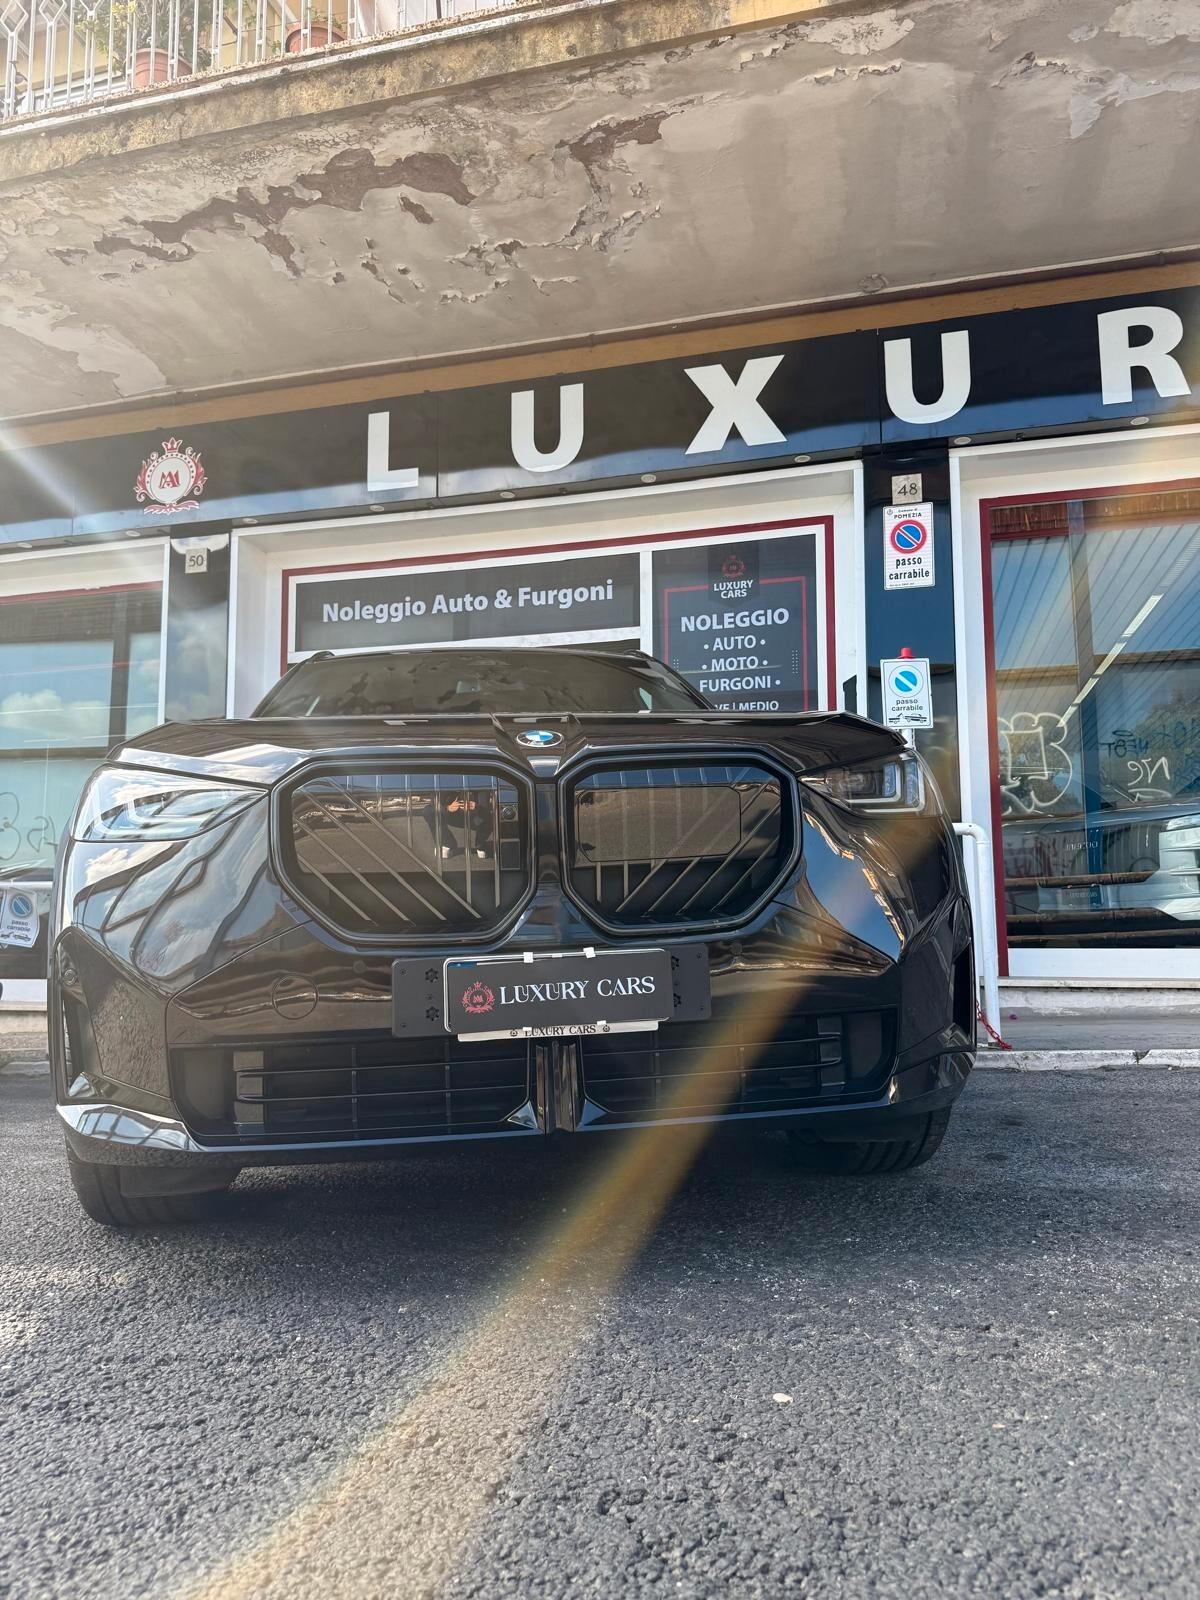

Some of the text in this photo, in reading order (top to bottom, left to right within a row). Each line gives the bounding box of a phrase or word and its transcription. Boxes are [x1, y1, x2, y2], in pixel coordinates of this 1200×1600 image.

[897, 482, 918, 496] 48
[189, 554, 204, 567] 50
[895, 556, 922, 569] passo
[888, 568, 930, 580] carrabile
[713, 579, 754, 592] LUXURY
[720, 588, 748, 599] CARS
[322, 578, 613, 624] Noleggio Auto & Furgoni
[680, 608, 790, 632] NOLEGGIO
[712, 634, 757, 651] AUTO
[710, 655, 759, 672] MOTO
[699, 675, 771, 693] FURGONI
[738, 700, 779, 711] MEDIO
[499, 975, 656, 1006] LUXURY CARS
[524, 1024, 597, 1037] LUXURY CARS
